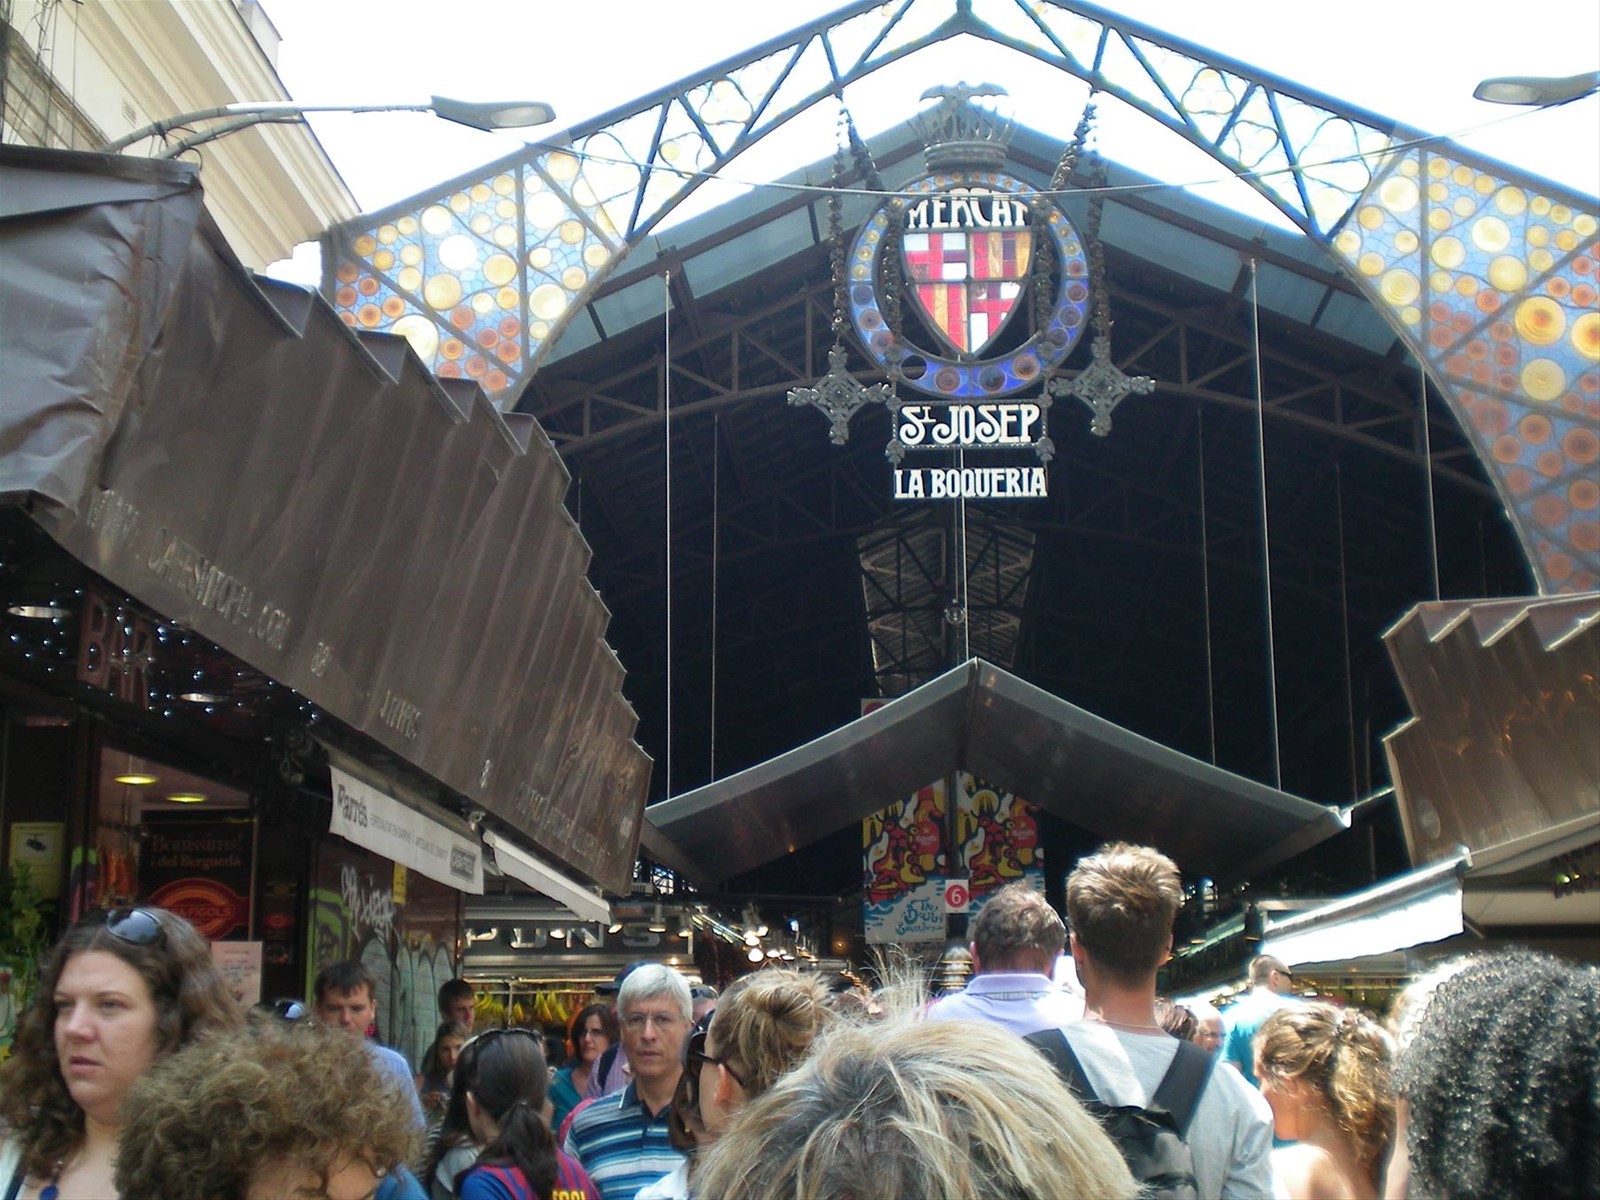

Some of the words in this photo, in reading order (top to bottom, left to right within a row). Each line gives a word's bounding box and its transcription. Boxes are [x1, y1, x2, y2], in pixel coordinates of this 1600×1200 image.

[907, 187, 1029, 229] MERCAT
[932, 403, 1040, 445] JOSEP
[894, 469, 925, 498] LA
[931, 467, 1048, 498] BOQUERIA
[76, 591, 152, 711] BAR
[951, 888, 962, 905] 6
